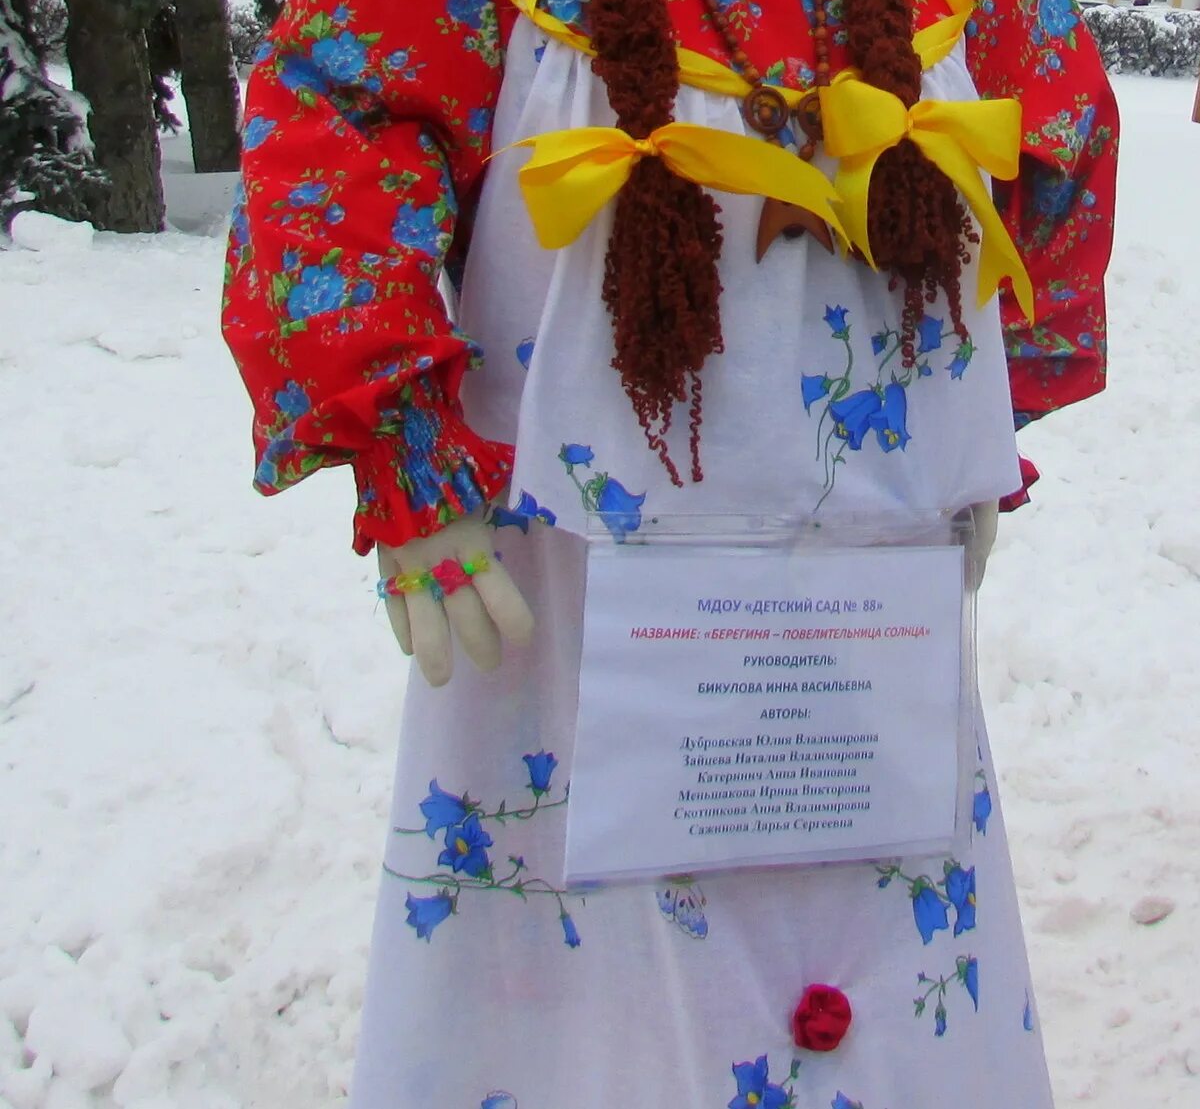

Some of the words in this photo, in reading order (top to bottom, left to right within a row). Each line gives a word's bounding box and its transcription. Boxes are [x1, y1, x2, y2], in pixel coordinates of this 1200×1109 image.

[698, 599, 741, 614] МДОУ
[745, 598, 812, 614] «ДЕТСКИЙ
[816, 600, 841, 614] САД
[843, 600, 857, 612] №
[863, 600, 883, 612] 88»
[631, 627, 700, 640] НАЗВАНИЕ:
[704, 628, 769, 640] «БЕРЕГИНЯ
[783, 627, 882, 640] ПОВЕЛИТЕЛЬНИЦА
[884, 626, 930, 639] СОЛНЦА»
[743, 655, 837, 668] РУКОВОДИТЕЛЬ:
[698, 682, 762, 694] БИКУЛОВА
[766, 681, 798, 693] ИННА
[801, 680, 872, 693] ВАСИЛЬЕВНА
[760, 708, 811, 719] АВТОРЫ:
[680, 736, 752, 751] Дубровская
[756, 734, 792, 746] Юлия
[796, 733, 879, 746] Владимировна
[790, 750, 874, 763] Владимировна
[766, 769, 796, 780] Анна
[800, 767, 857, 778] Ивановна
[802, 784, 870, 797] Викторовна
[750, 804, 781, 815] Анна
[785, 801, 870, 814] Владимировна
[793, 818, 853, 832] Сергеевна
